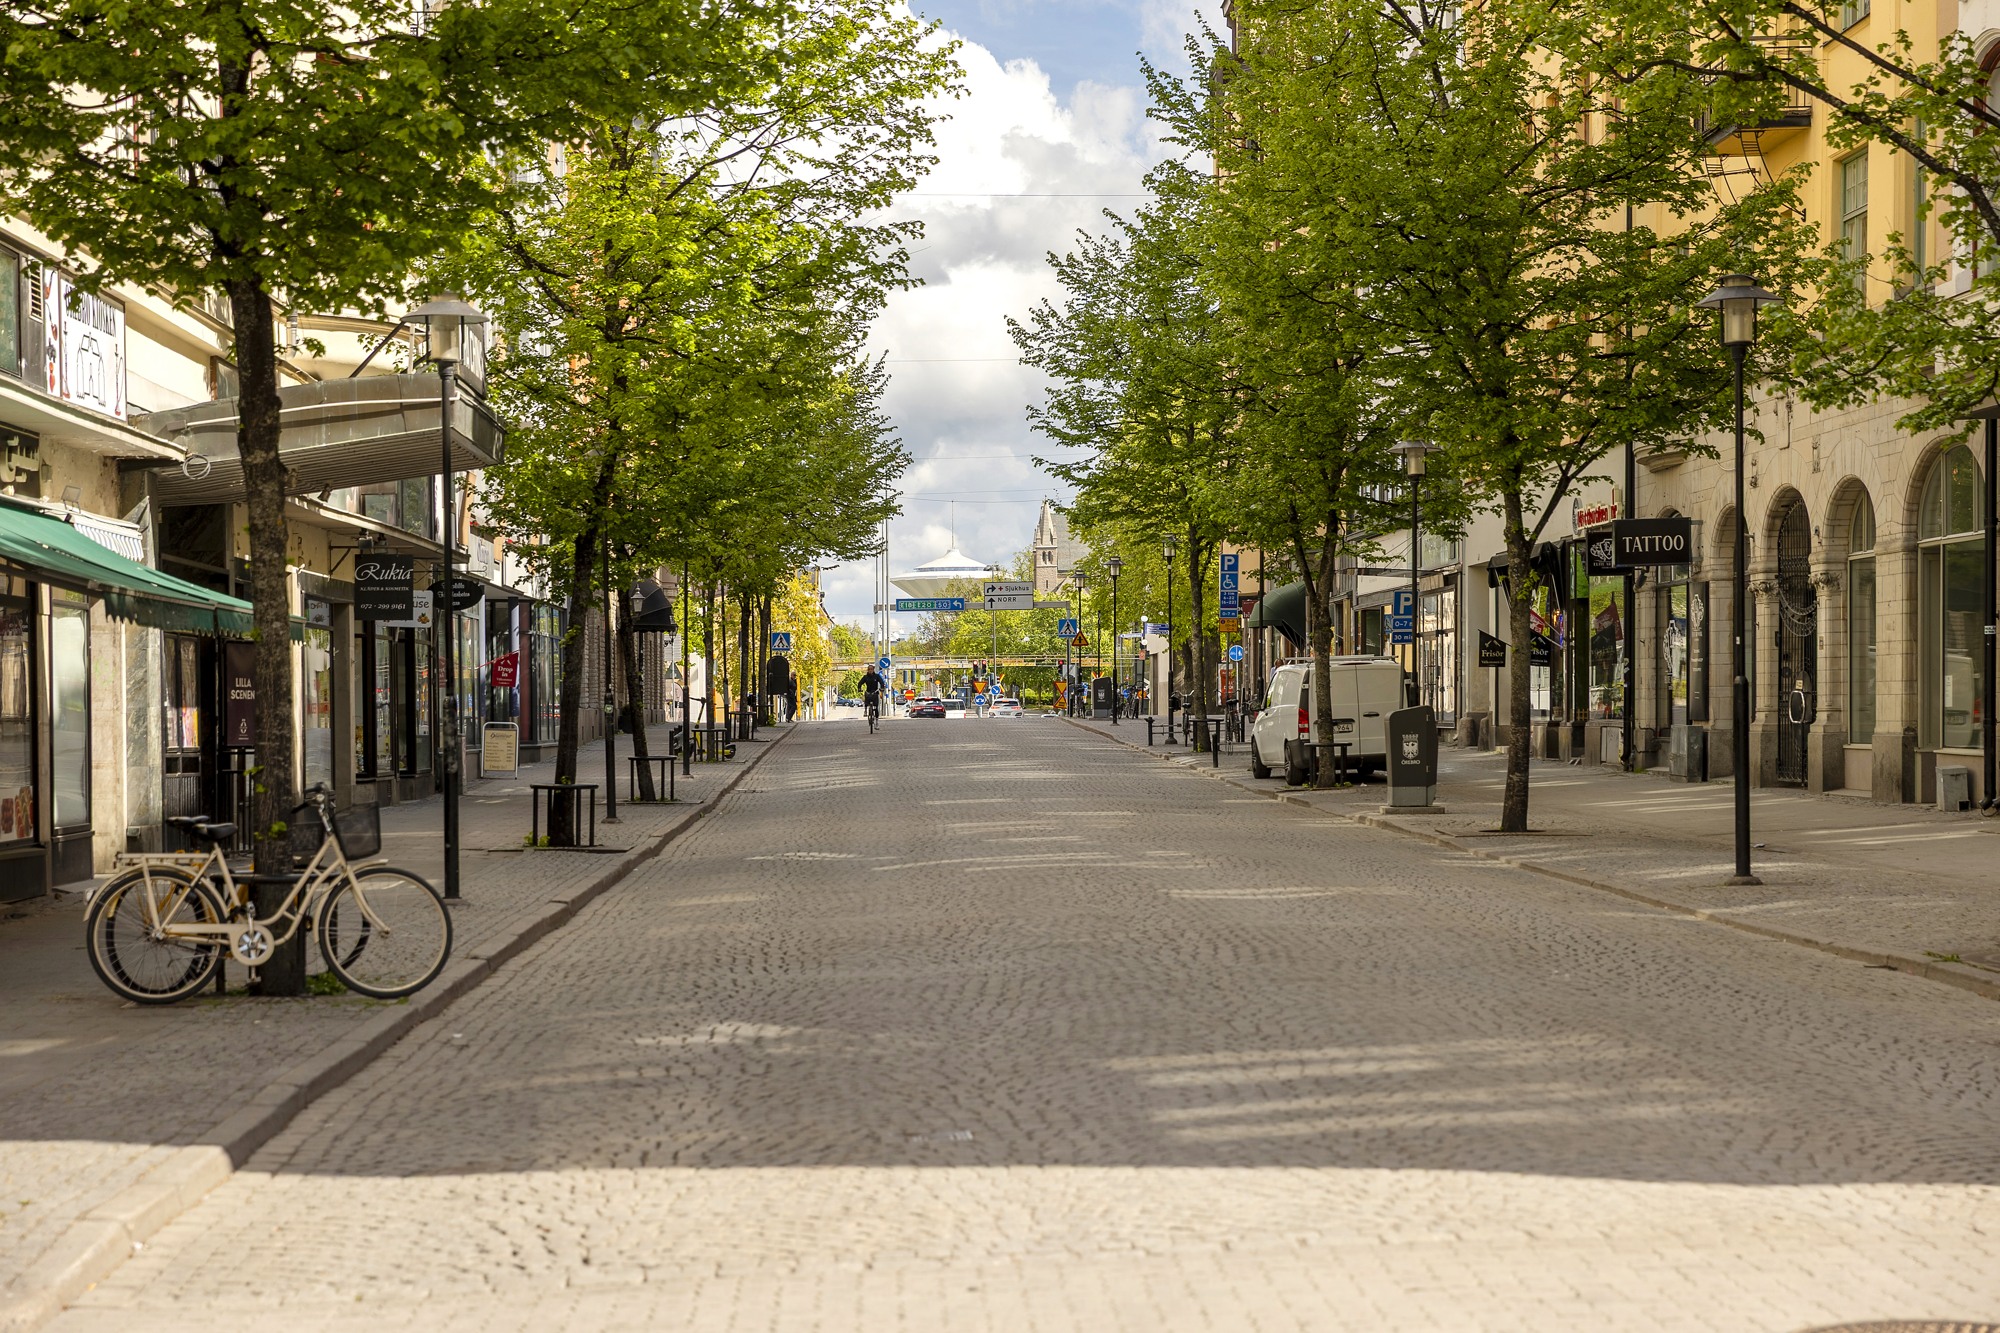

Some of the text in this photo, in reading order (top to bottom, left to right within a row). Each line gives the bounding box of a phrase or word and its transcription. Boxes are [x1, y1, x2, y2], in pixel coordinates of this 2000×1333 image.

[1622, 535, 1685, 553] TATTOO
[1224, 556, 1235, 571] P
[355, 563, 414, 581] Rukia
[1400, 593, 1413, 615] P
[235, 677, 252, 687] LILLA
[230, 690, 256, 699] SCENEN
